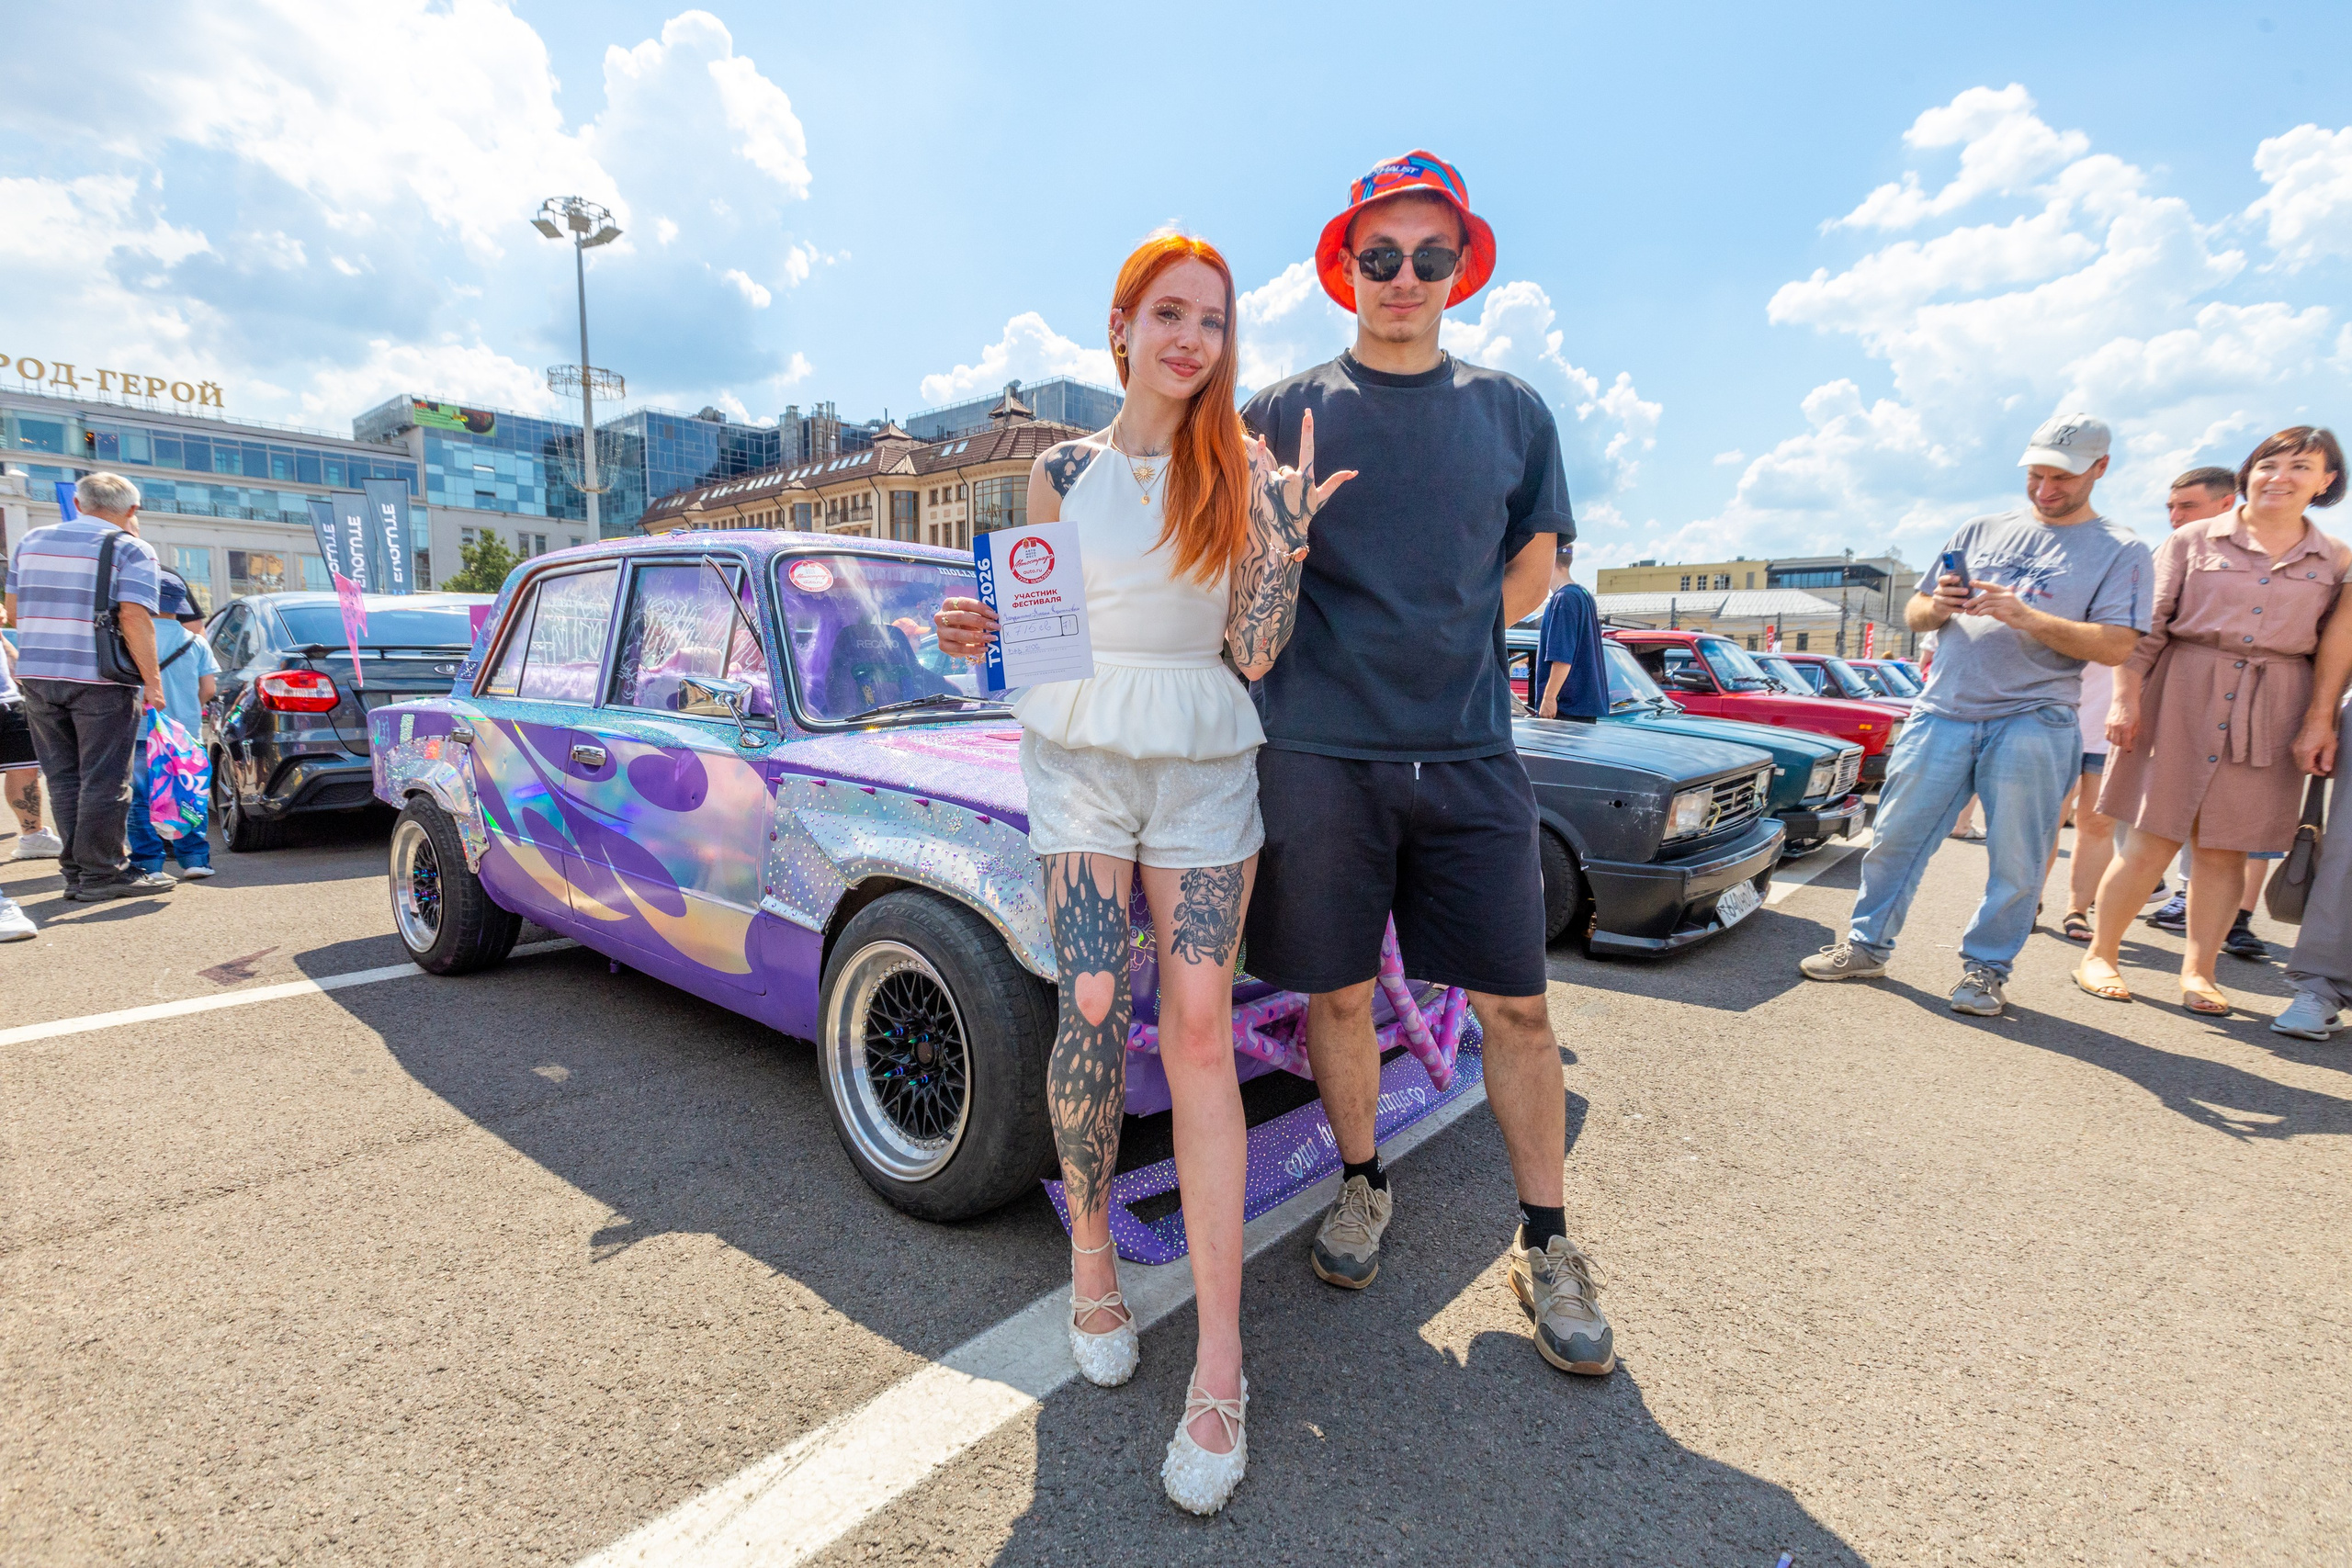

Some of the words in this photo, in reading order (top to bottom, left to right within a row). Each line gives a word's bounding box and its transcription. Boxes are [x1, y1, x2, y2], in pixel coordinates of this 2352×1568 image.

[978, 558, 995, 607] 2026
[1014, 589, 1057, 600] УЧАСТНИК
[1012, 596, 1062, 609] ФЕСТИВАЛЯ
[856, 639, 899, 651] RECARO
